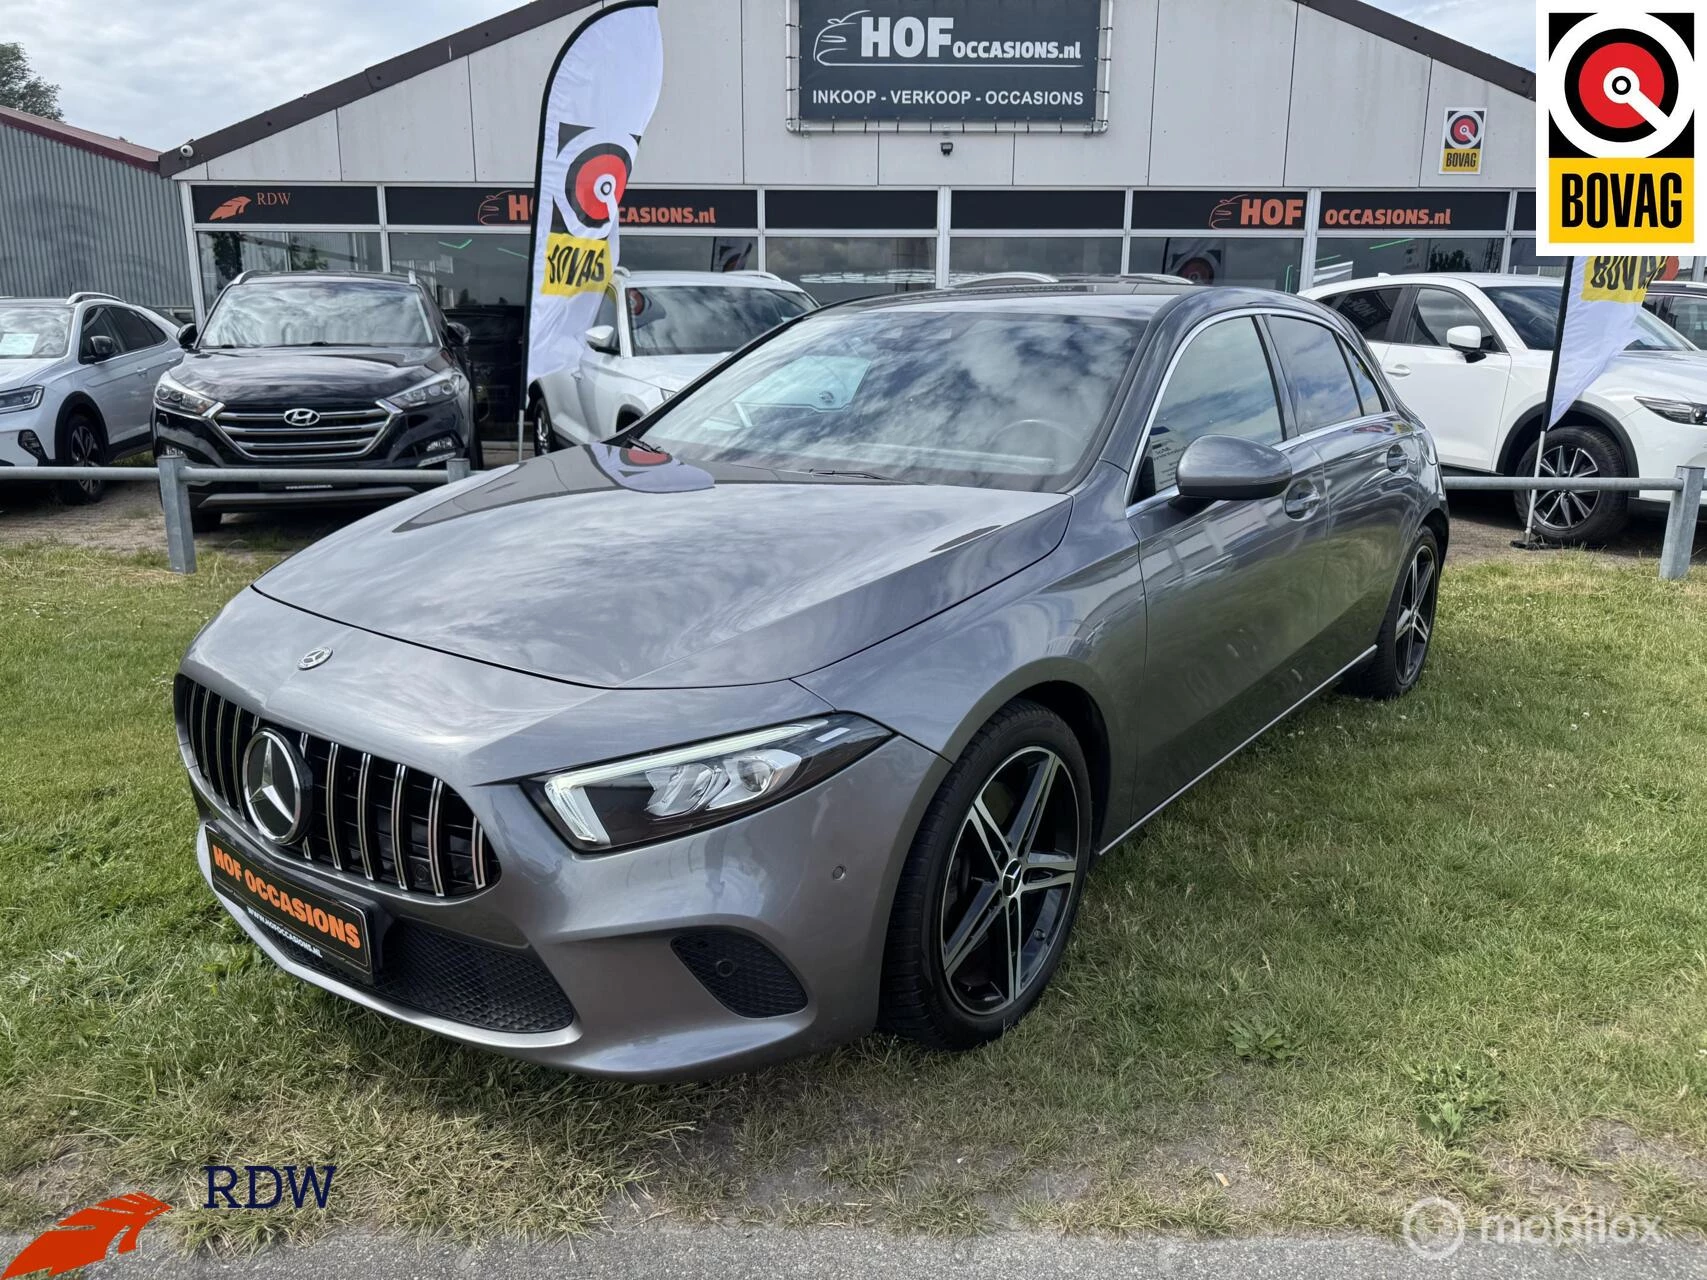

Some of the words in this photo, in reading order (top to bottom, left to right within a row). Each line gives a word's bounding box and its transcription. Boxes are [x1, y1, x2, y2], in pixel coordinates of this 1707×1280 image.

[812, 90, 876, 104] INKOOP
[890, 91, 972, 105] VERKOOP
[985, 91, 1084, 106] OCCASIONS
[1446, 152, 1477, 167] BOVAG
[257, 192, 291, 206] RDW
[618, 207, 716, 224] CASIONS.nl
[1240, 199, 1304, 226] HOF
[1325, 208, 1451, 226] OCCASIONS.nl
[1591, 256, 1664, 290] BOVA
[212, 844, 242, 881] HOF
[245, 868, 361, 949] OCCASIONS
